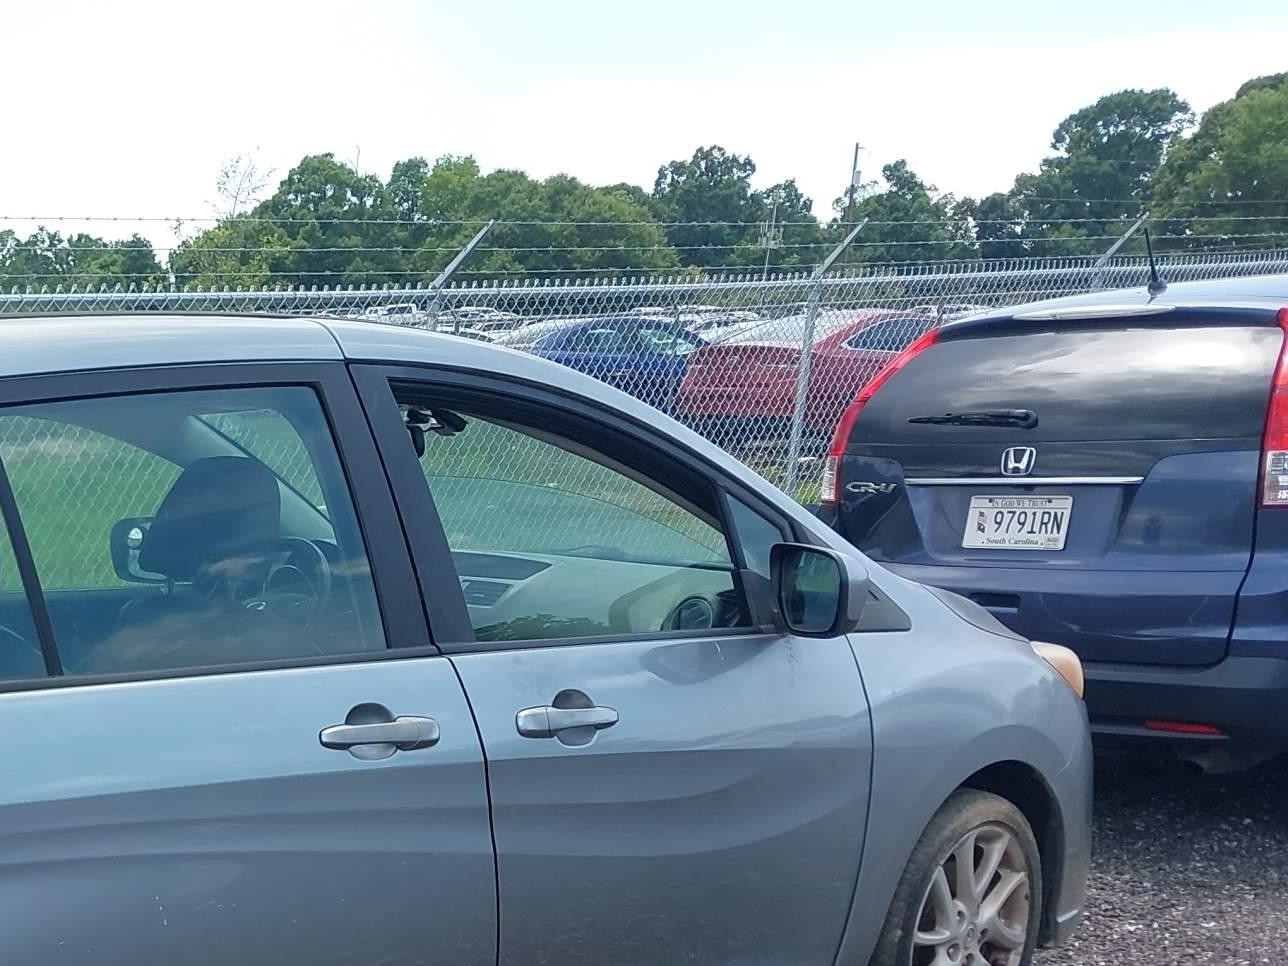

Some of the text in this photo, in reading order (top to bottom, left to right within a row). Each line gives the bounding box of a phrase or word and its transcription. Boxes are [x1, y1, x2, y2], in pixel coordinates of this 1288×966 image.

[845, 481, 896, 493] CR-V
[1001, 499, 1014, 507] GOD
[1015, 499, 1025, 507] WE
[1028, 499, 1048, 507] TRUST
[994, 510, 1064, 534] 9791RN
[986, 536, 1007, 545] South
[1008, 536, 1039, 545] Carolina
